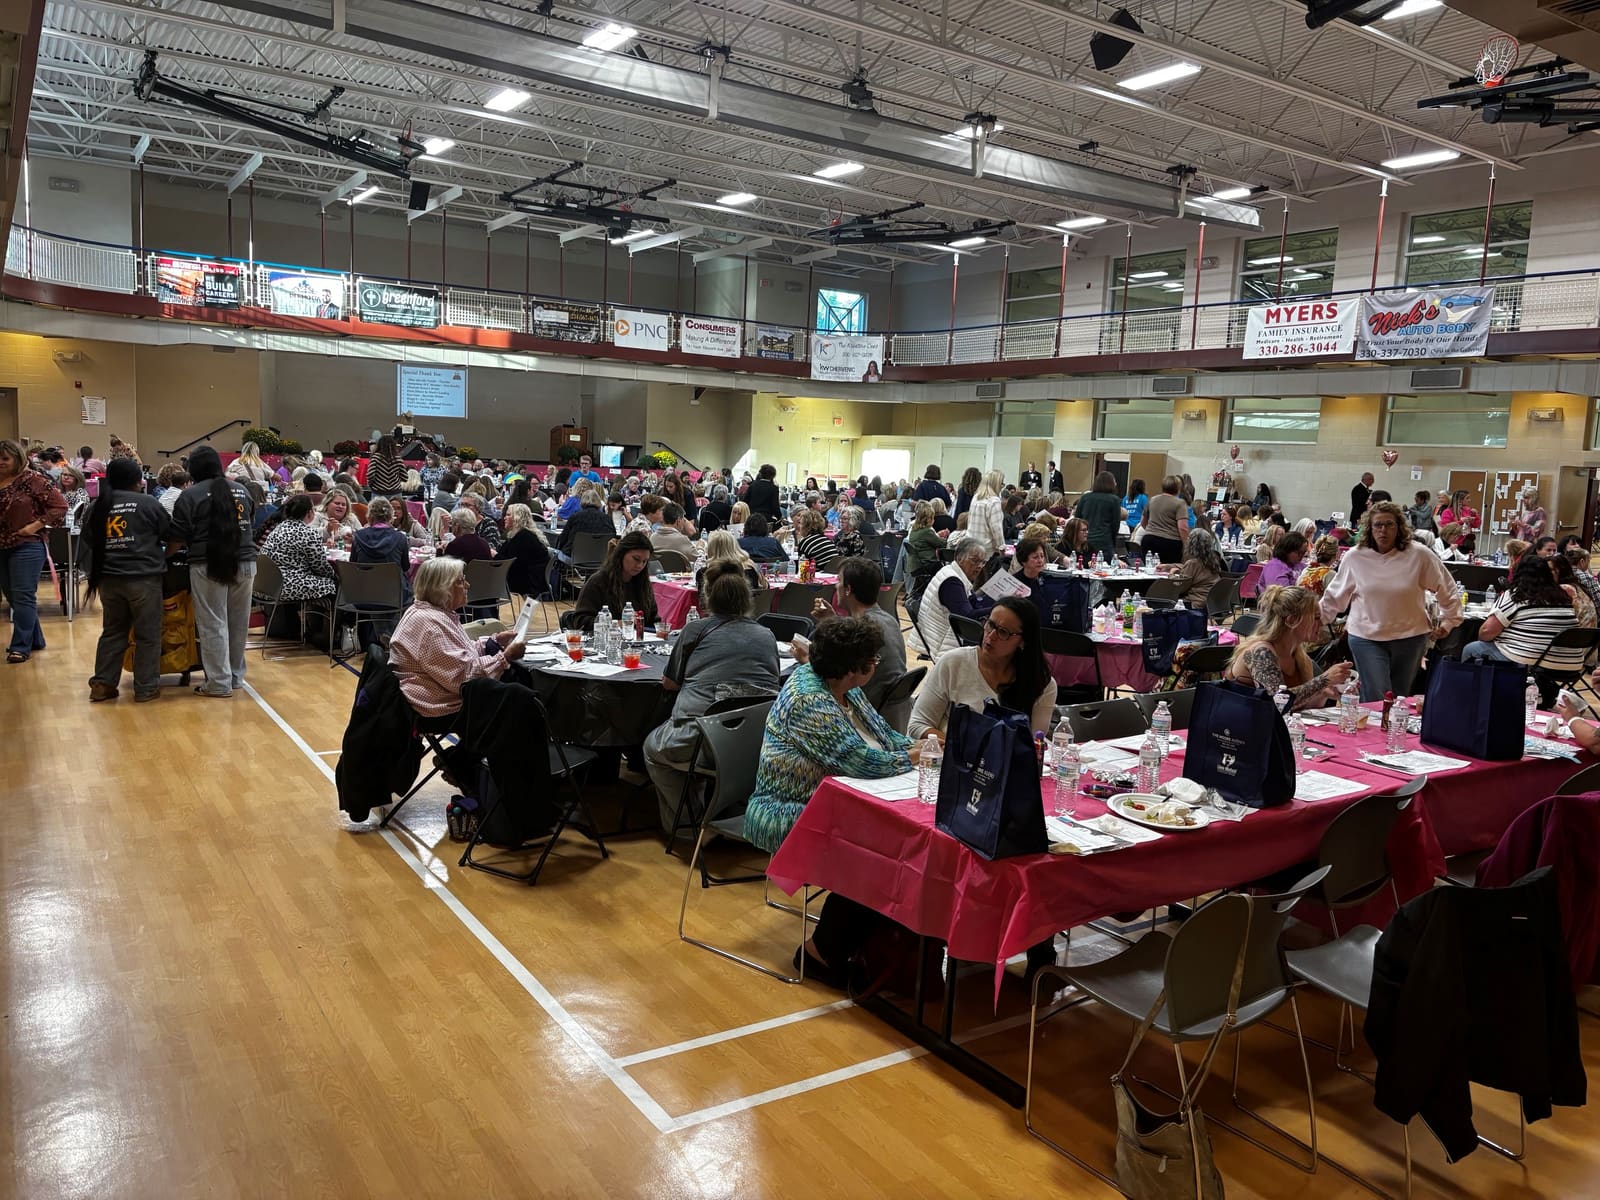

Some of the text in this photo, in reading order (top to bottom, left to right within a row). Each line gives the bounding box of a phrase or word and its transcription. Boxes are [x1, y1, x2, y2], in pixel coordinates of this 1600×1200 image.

[205, 281, 234, 292] BUILD
[205, 290, 237, 299] CAREERS!
[382, 290, 435, 309] greenford
[1265, 302, 1338, 324] MYERS
[1368, 299, 1441, 336] Nick's
[634, 322, 667, 340] PNC
[685, 319, 737, 334] CONSUMERS
[1257, 324, 1344, 338] FAMILY INSURANCE
[1397, 322, 1477, 337] AUTO BODY
[685, 333, 704, 343] Making
[710, 337, 737, 345] Difference
[1385, 338, 1402, 346] Your
[1404, 337, 1423, 346] Body
[1436, 336, 1452, 344] Our
[1258, 341, 1338, 357] 330-286-3044
[1359, 347, 1427, 358] 330-337-7030
